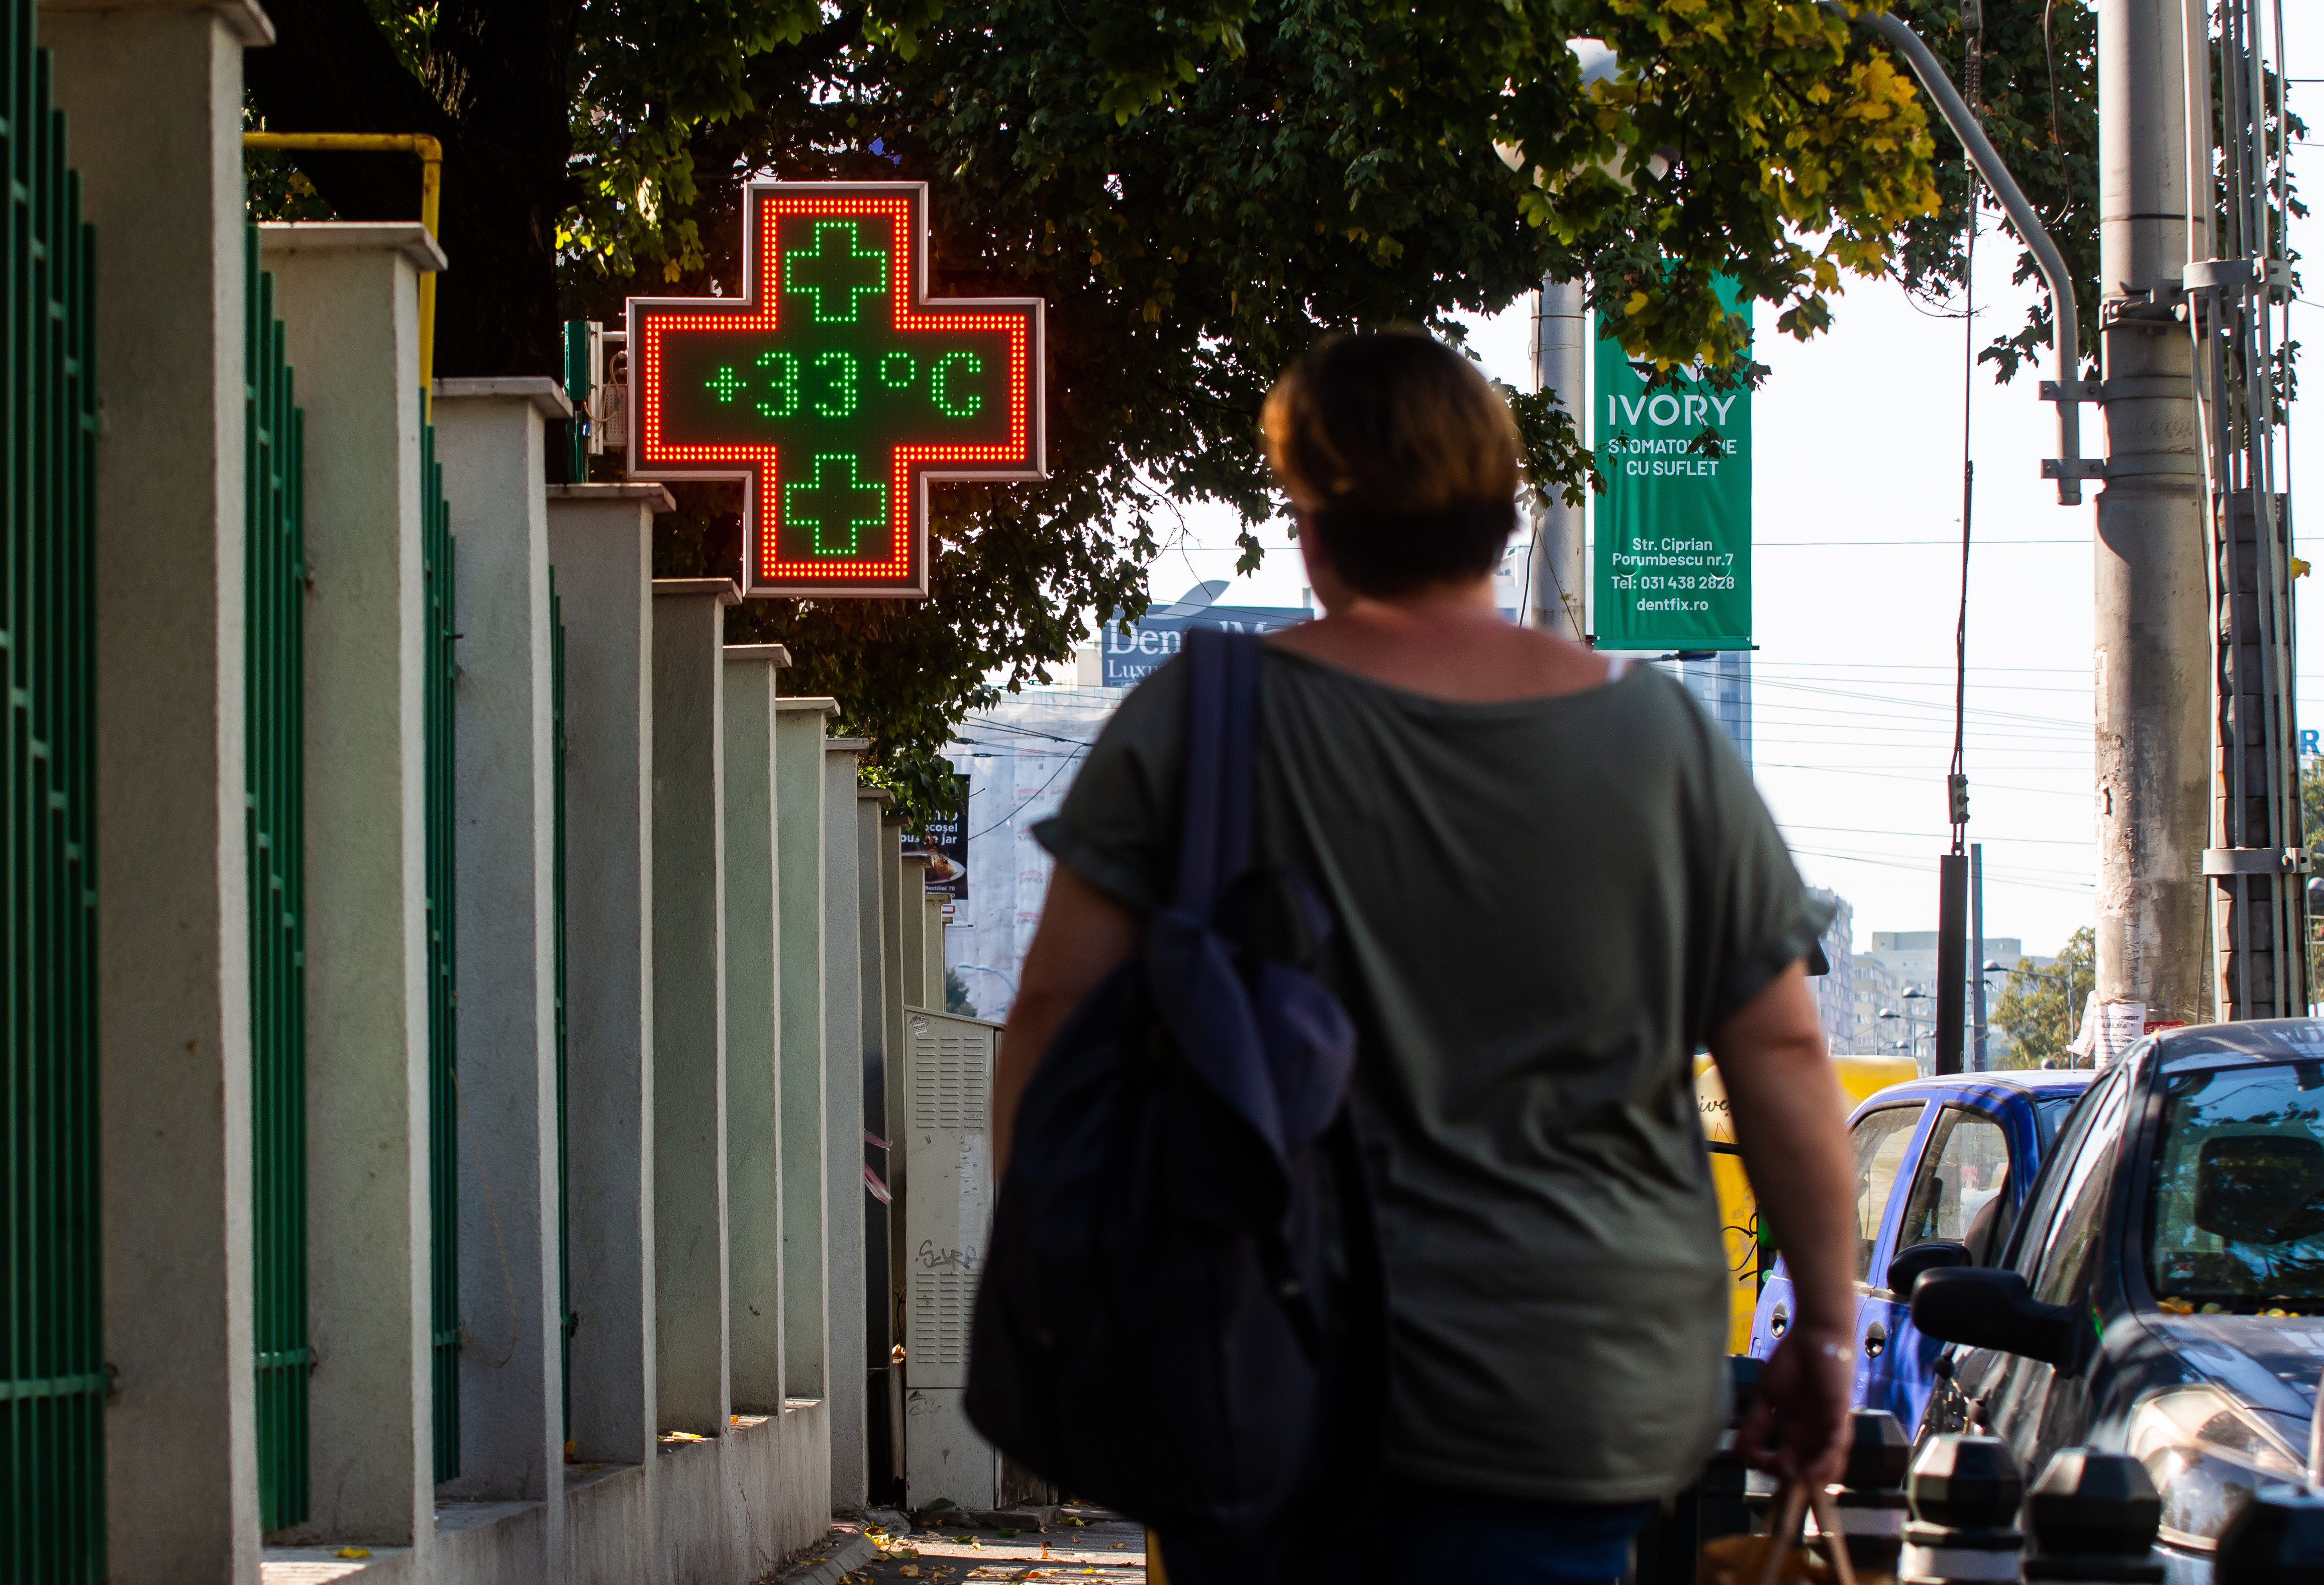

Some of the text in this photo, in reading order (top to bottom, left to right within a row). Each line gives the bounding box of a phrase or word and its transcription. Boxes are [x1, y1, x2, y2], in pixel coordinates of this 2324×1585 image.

[1608, 394, 1737, 426] IVORY
[1608, 439, 1737, 454] STOMATOIE
[1626, 460, 1719, 475] CU SUFLET
[1632, 538, 1712, 555] Str. Ciprian
[1612, 553, 1703, 566] Porumbescu
[1611, 576, 1735, 589] Tel: 031 438 2828
[1637, 598, 1708, 611] dentfix.ro
[941, 833, 958, 846] jar
